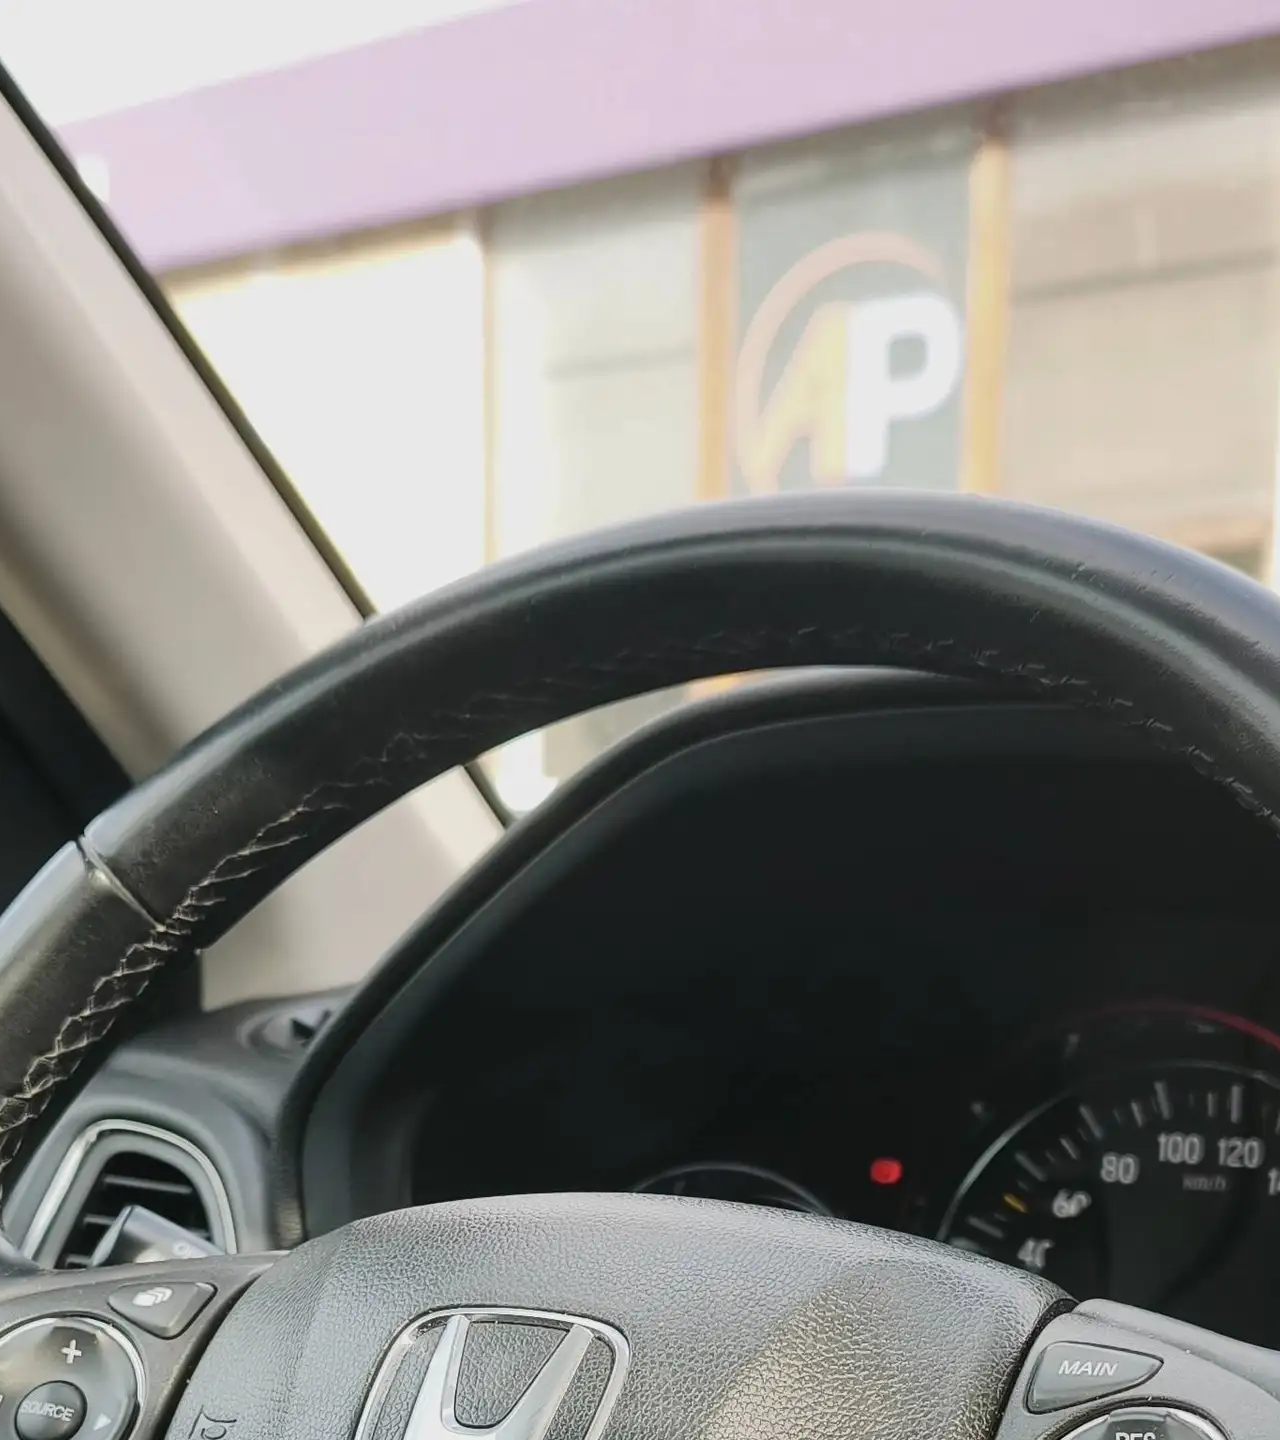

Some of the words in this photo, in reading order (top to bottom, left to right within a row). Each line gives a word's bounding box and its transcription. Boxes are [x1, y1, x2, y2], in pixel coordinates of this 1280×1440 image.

[1157, 1132, 1204, 1166] 100
[1217, 1136, 1265, 1169] 120
[1100, 1152, 1139, 1185] 80
[1052, 1188, 1092, 1218] 60
[1058, 1359, 1119, 1377] MAIN
